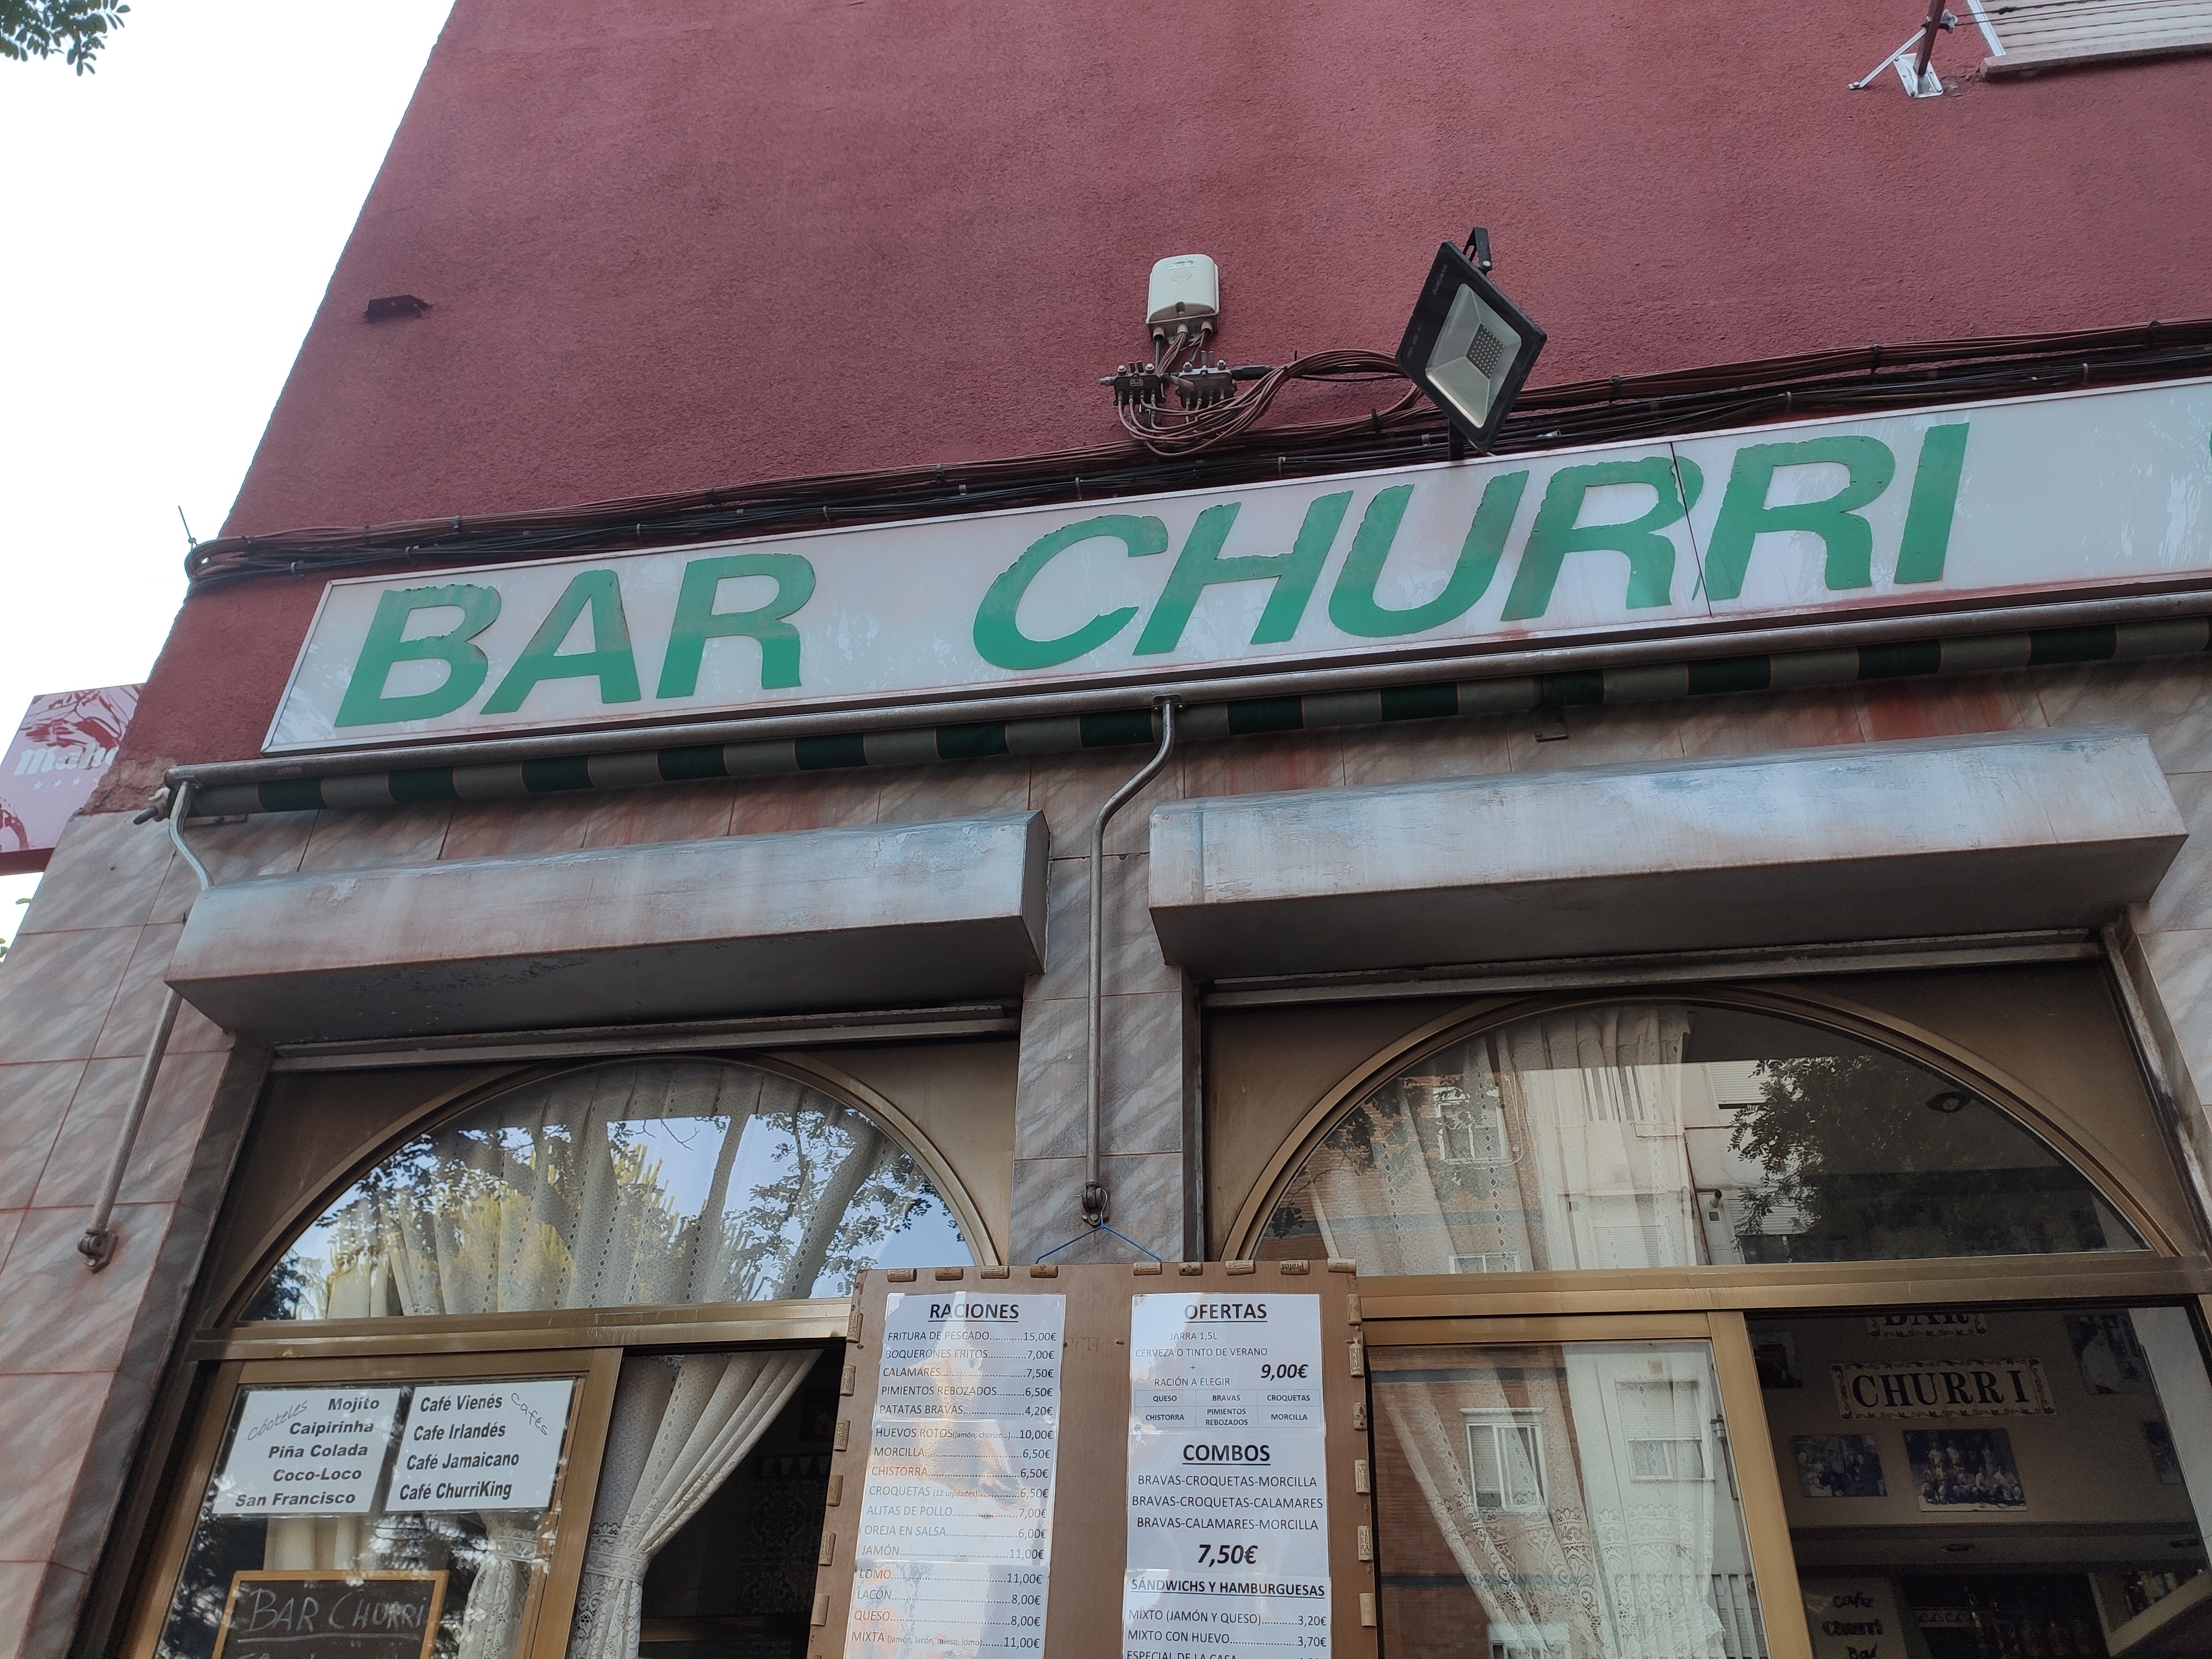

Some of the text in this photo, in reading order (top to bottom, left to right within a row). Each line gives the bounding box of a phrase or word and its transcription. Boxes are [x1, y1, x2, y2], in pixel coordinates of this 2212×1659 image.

[333, 423, 1969, 727] BAR CHURRI
[1281, 1261, 1305, 1271] Protos
[930, 1303, 1019, 1319] RACIONES
[1184, 1304, 1267, 1319] OFERTAS
[888, 1331, 1057, 1343] FRITURA DE PESCADO 15,00€
[1169, 1332, 1218, 1341] JARRA 1,5L
[886, 1349, 1055, 1361] BOQUERONES FRITOS 7,00€
[1135, 1348, 1174, 1357] CERVEZA
[1177, 1348, 1183, 1357] O
[1186, 1348, 1213, 1357] TINTO
[1230, 1348, 1267, 1356] VERANO
[883, 1367, 1054, 1380] CALAMARES 7,50€
[1261, 1364, 1308, 1381] 9,00€
[1154, 1376, 1230, 1386] RACIÓN A ELEGIR
[1852, 1370, 2030, 1407] CHURRI
[881, 1386, 1053, 1399] PIMIENTOS REBOZADOS 6,50€
[1267, 1394, 1310, 1402] CROQUETAS
[328, 1397, 379, 1413] Mojito
[420, 1392, 503, 1412] Café Vienés
[879, 1405, 1053, 1417] PATATAS BRAVAS 4,20€
[290, 1421, 373, 1437] Caipirinha
[448, 1421, 505, 1439] Irlandés
[876, 1428, 916, 1438] HUEVOS
[1020, 1430, 1053, 1441] 10,00€
[268, 1444, 368, 1458] Piña Colada
[874, 1447, 1051, 1460] MORCILLA 6,50€
[1183, 1444, 1270, 1462] COMBOS
[407, 1452, 519, 1470] Café Jamaicano
[273, 1468, 362, 1481] Coco-Loco
[872, 1467, 1048, 1480] CHISTORRA 6,50€
[1138, 1475, 1317, 1487] BRAVAS-CROQUETAS-MORCILLA
[399, 1480, 512, 1500] Café ChurriKing
[869, 1486, 930, 1497] CROQUETAS
[932, 1489, 943, 1498] (12
[1020, 1488, 1048, 1499] 6,50€
[236, 1491, 355, 1507] San Francisco
[1132, 1496, 1323, 1509] BRAVAS-CROQUETAS-CALAMARES
[867, 1506, 1047, 1520] ALITAS DE POLLO 7,00€
[1137, 1517, 1318, 1530] BRAVAS-CALAMARES-MORCILLA
[864, 1525, 1047, 1540] OREJA EN SALSA 6,00€
[861, 1543, 1044, 1561] JAMÓN 11,00€
[1198, 1544, 1258, 1567] 7,50€
[859, 1569, 1042, 1585] LOMO 11,00€
[1131, 1577, 1325, 1597] SÁNDWICHS Y HAMBURGUESAS
[857, 1588, 1041, 1606] LACÓN 8,00€
[246, 1588, 320, 1632] BAR
[1129, 1609, 1327, 1626] MIXTO (JAMÓN Y QUESO) 3,20€
[854, 1610, 1040, 1628] QUESO 8,00€
[852, 1632, 885, 1642] MIXTA
[1004, 1636, 1040, 1649] 11,00€
[1128, 1630, 1327, 1647] MIXTO CON HUEVO 3,70€
[1127, 1651, 1172, 1659] ESPECIAL
